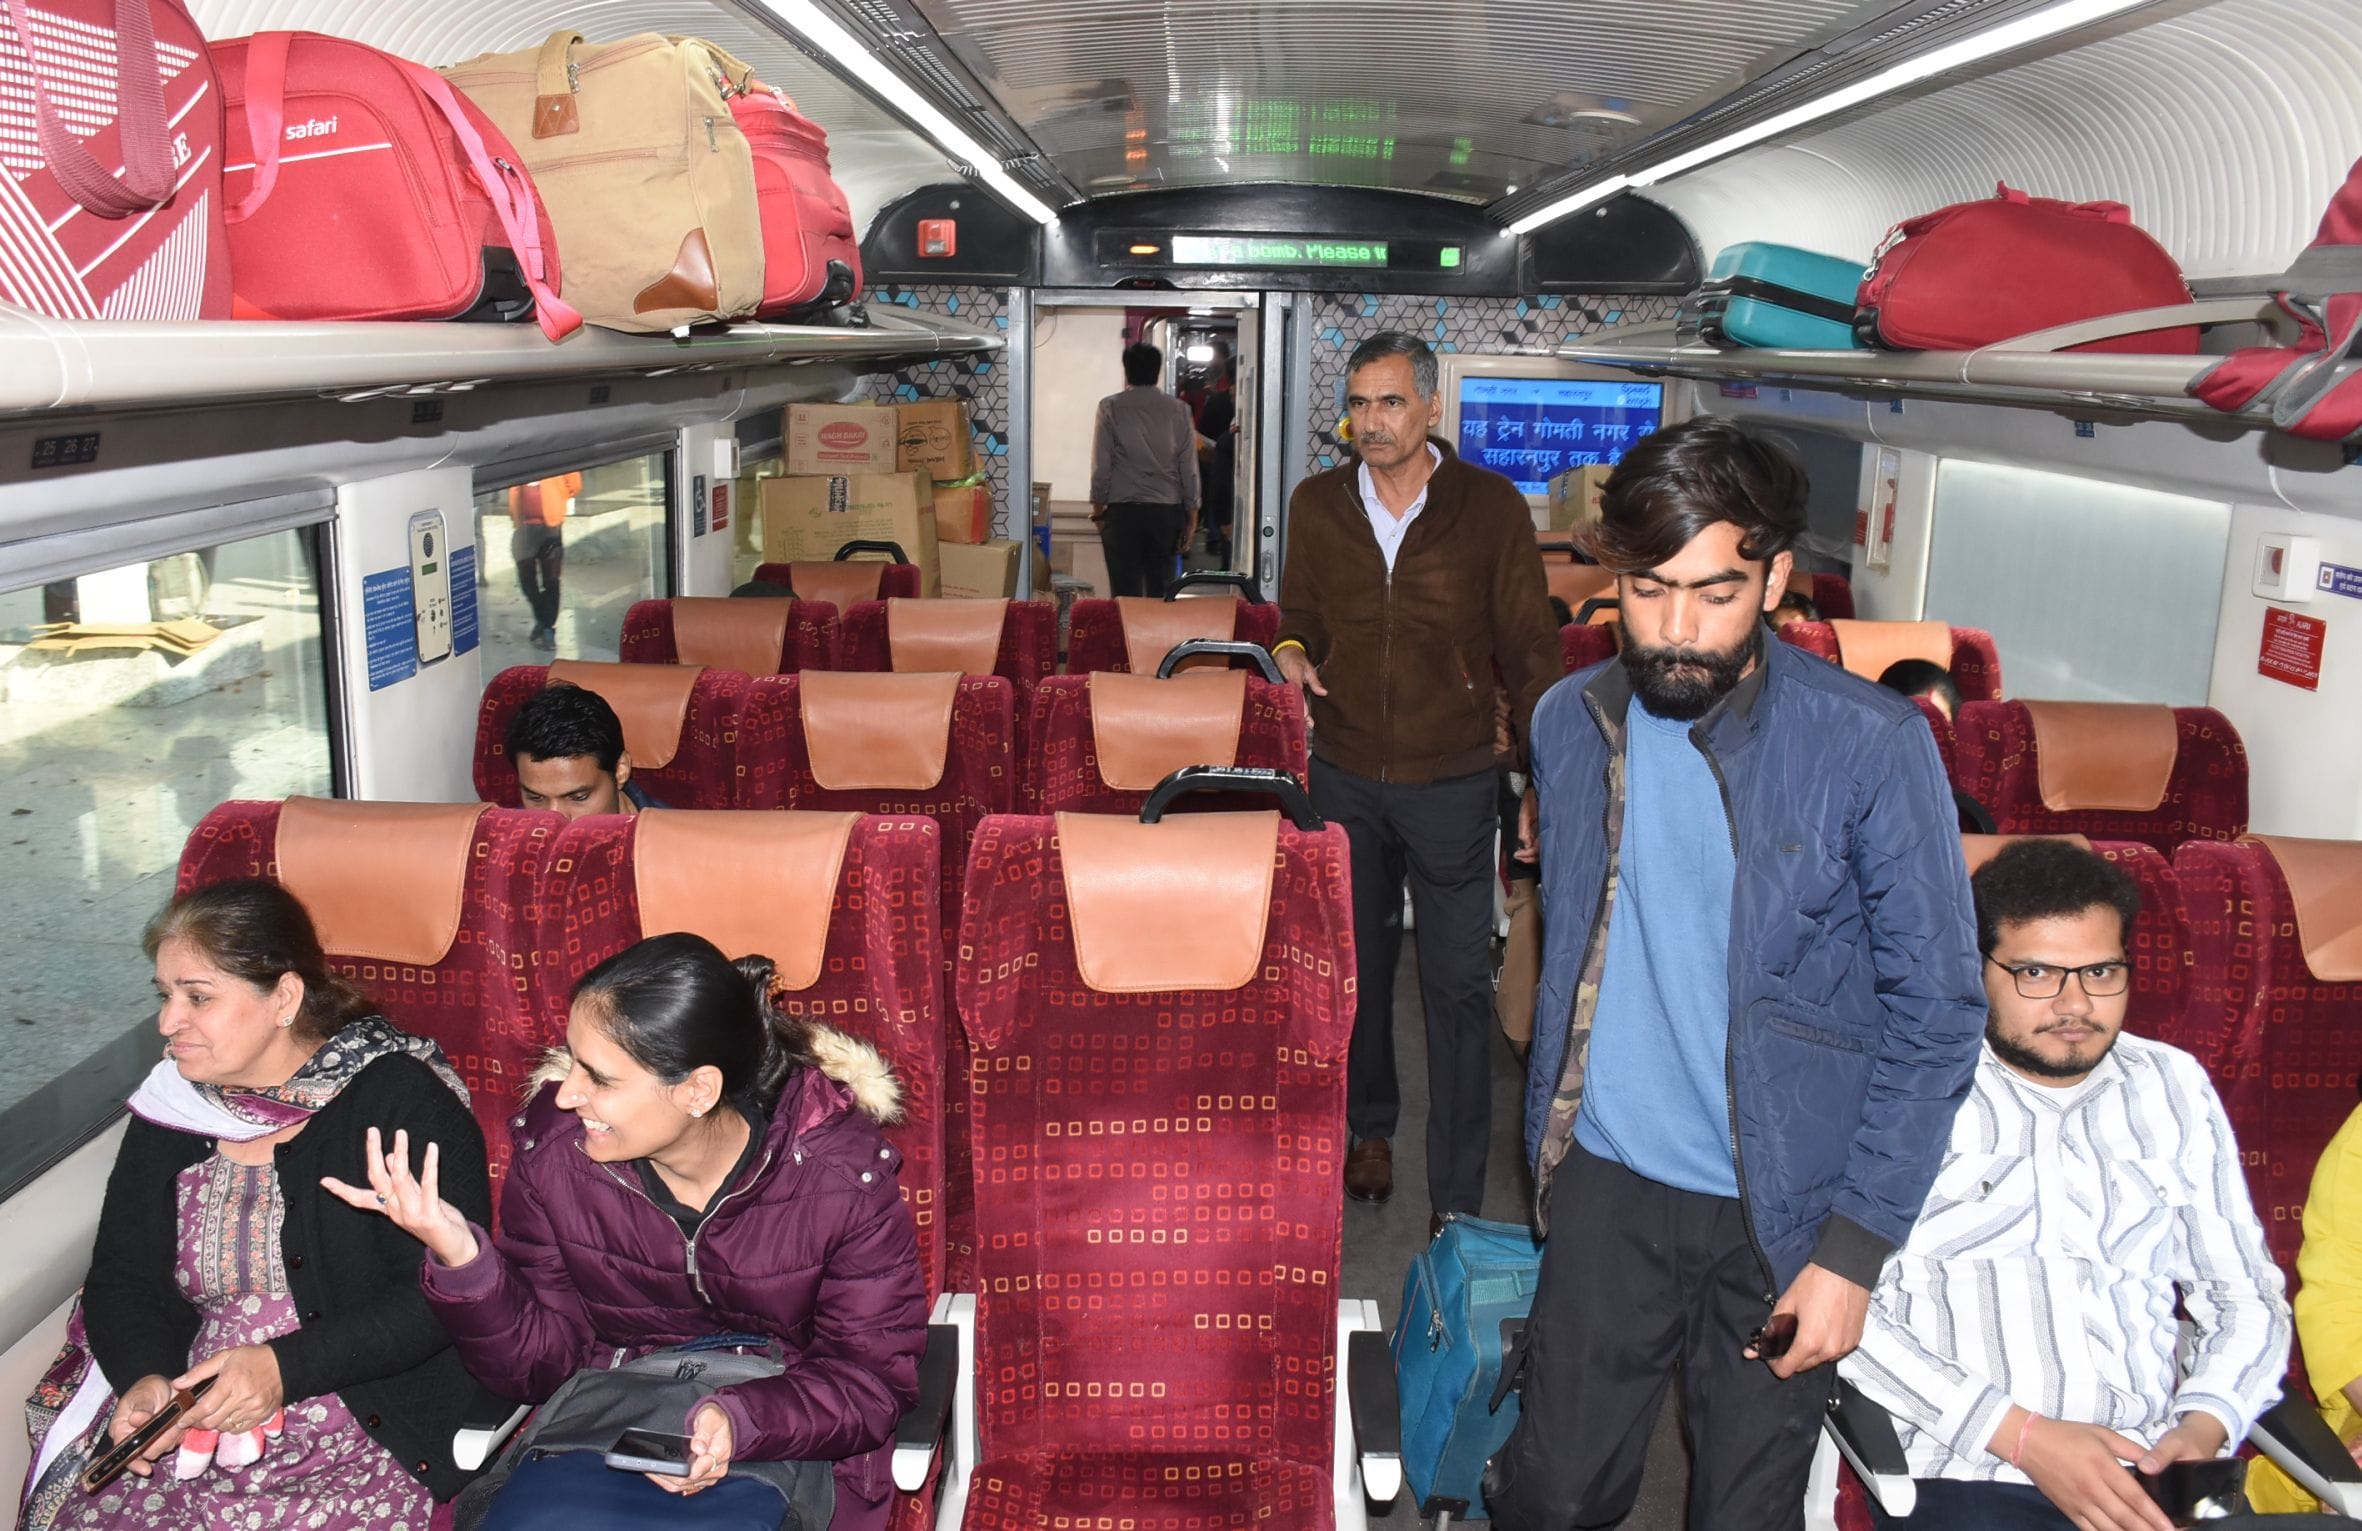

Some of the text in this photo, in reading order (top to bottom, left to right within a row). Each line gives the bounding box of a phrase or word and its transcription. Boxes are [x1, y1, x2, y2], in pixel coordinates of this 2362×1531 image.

[285, 116, 338, 140] safari
[1247, 242, 1302, 259] bomb.
[1305, 244, 1371, 260] Please
[1461, 420, 1489, 439] यह
[1496, 415, 1525, 442] ट्रेन
[1532, 416, 1585, 440] गोमती
[1592, 424, 1631, 441] नगर
[1481, 448, 1561, 473] सहारनपुर
[1567, 450, 1600, 468] तक
